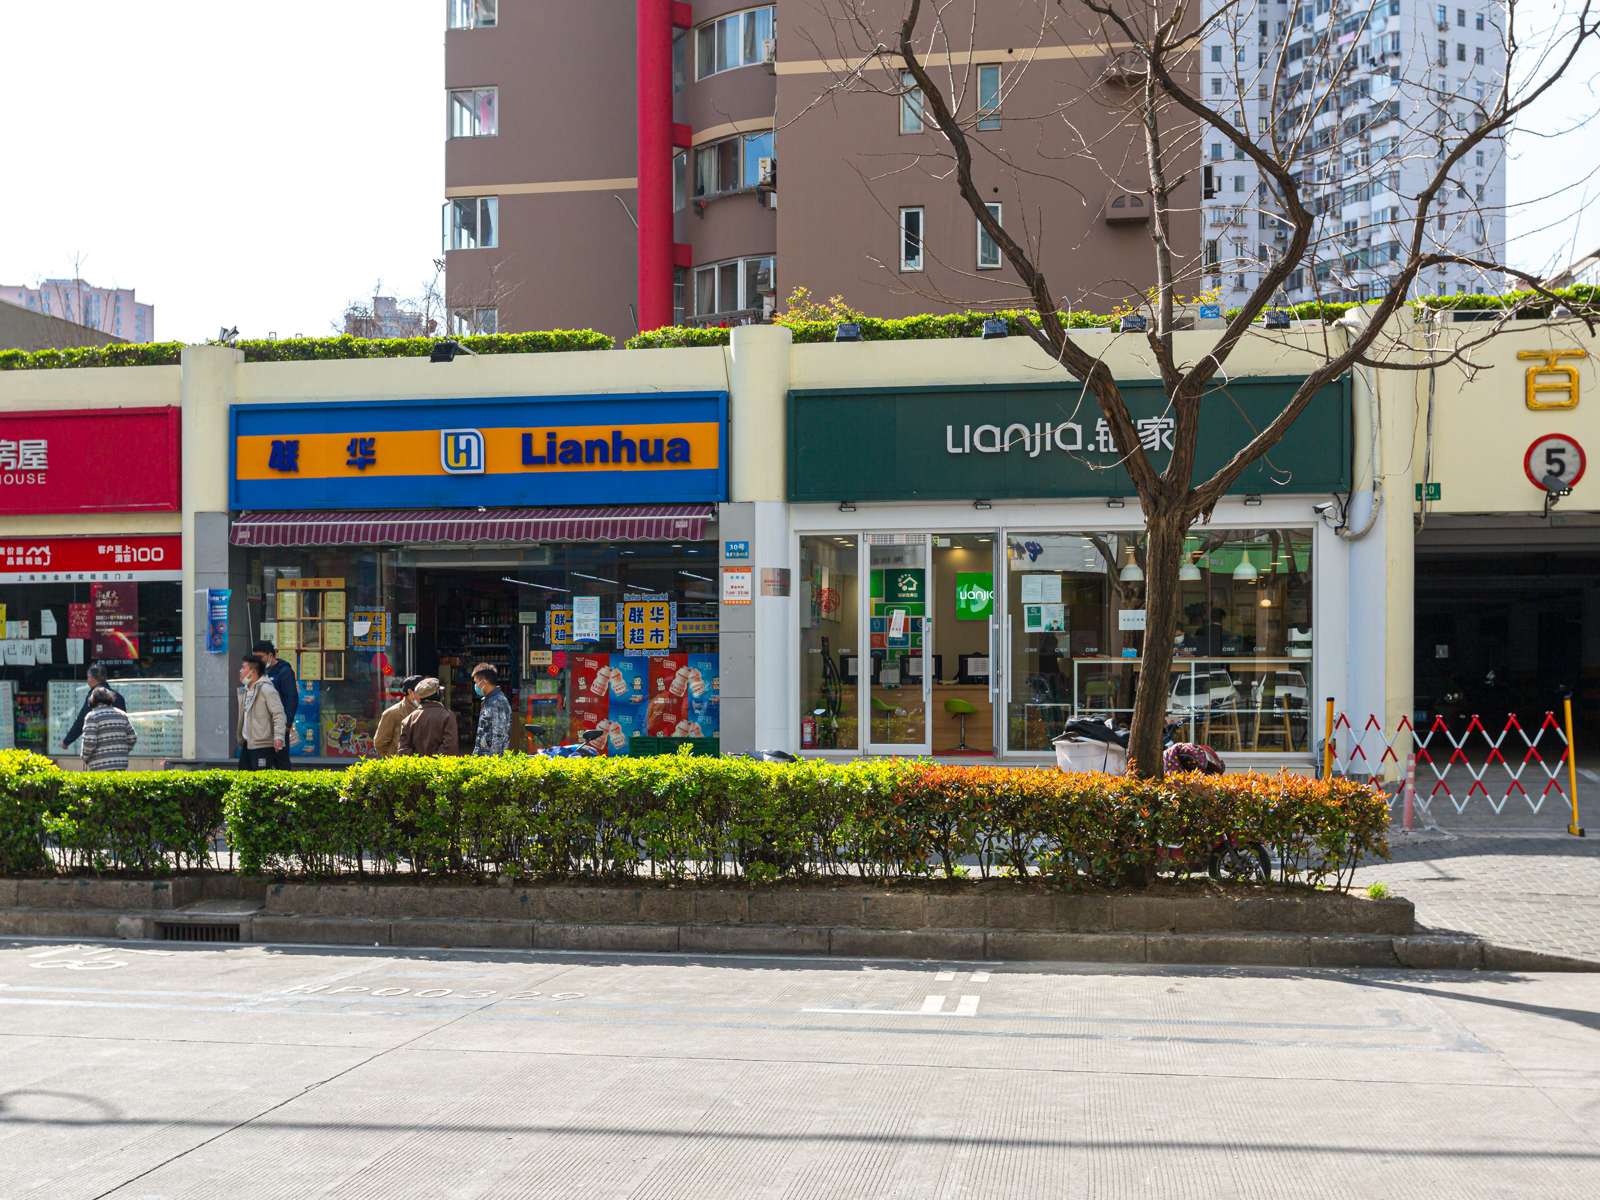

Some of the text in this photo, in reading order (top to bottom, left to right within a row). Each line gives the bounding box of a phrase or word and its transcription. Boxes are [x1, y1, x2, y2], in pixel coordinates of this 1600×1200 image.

[1516, 348, 1587, 410] 百
[0, 438, 49, 471] 房屋
[268, 434, 377, 473] 联华
[521, 429, 691, 467] Lianhua
[1545, 447, 1566, 478] 5
[0, 472, 47, 485] OUSE
[98, 545, 131, 555] 客户至上
[729, 543, 745, 551] 30号
[132, 547, 164, 562] 100
[17, 573, 134, 582] 上海市金桥奖规范门店
[289, 579, 333, 588] 商品信息
[624, 593, 668, 602] Lianhua Supermarket
[628, 606, 665, 624] 联华
[629, 627, 665, 645] 超市
[7, 643, 49, 656] 已消毒
[624, 649, 669, 658] Lianhua Supermarket
